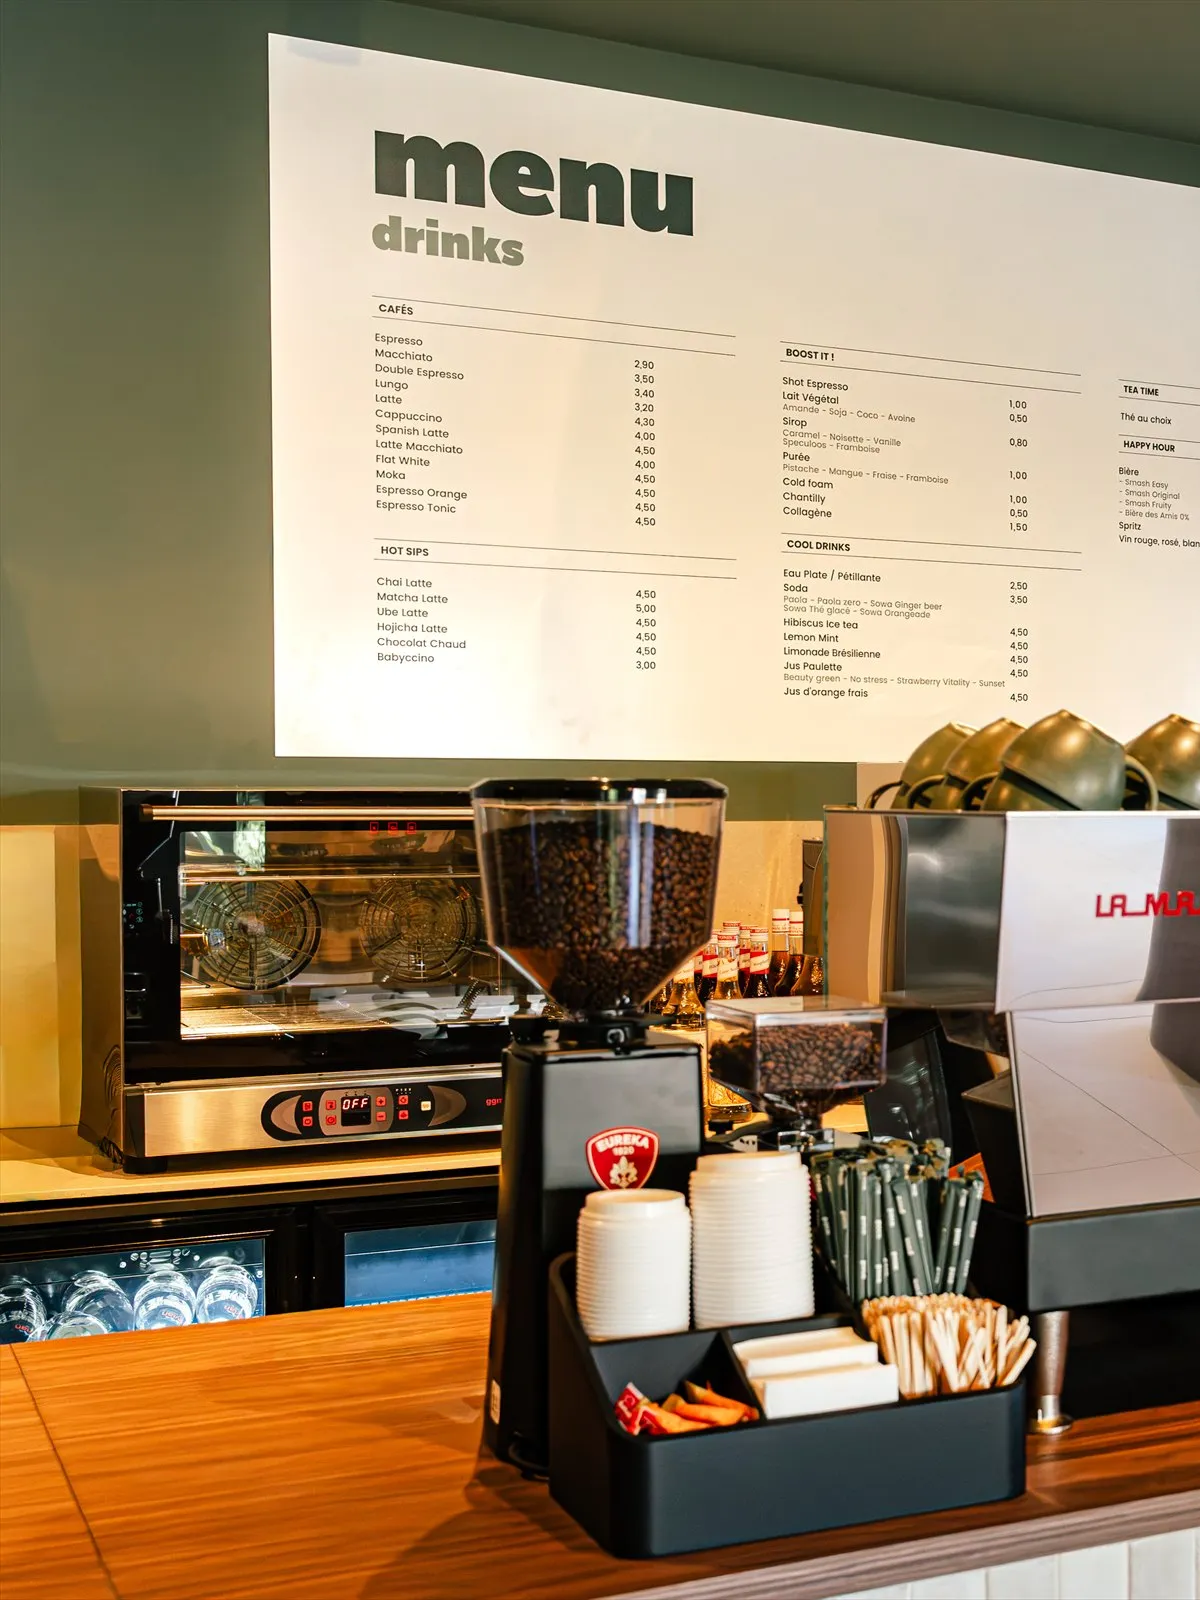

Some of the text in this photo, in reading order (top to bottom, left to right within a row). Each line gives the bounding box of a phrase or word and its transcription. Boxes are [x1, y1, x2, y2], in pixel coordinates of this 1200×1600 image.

[374, 130, 694, 237] menu
[372, 215, 525, 266] drinks
[378, 302, 414, 315] CAFÉS
[374, 332, 423, 346] Espresso
[374, 347, 433, 362] Macchiato
[785, 347, 830, 360] BOOST IT
[633, 359, 655, 370] 2,90
[374, 363, 465, 381] Double Espresso
[374, 378, 409, 391] Lungo
[633, 373, 655, 384] 3,50
[781, 375, 849, 392] Shot Espresso
[633, 387, 655, 399] 3,40
[1123, 384, 1160, 396] TEA TIME
[374, 393, 403, 404] Latte
[781, 390, 839, 405] Lait Végétal
[1008, 398, 1028, 409] 1,00
[633, 402, 655, 413] 3,20
[782, 402, 916, 423] Amande Soja Coco Avoine
[374, 408, 443, 423] Cappuccino
[633, 416, 655, 426] 4,30
[1008, 412, 1028, 423] 0,50
[1120, 411, 1172, 425] Thé au choix
[782, 416, 808, 429] Sirop
[374, 423, 449, 438] Spanish Latte
[633, 430, 655, 441] 4,00
[782, 428, 901, 447] Caramel Vanille
[1008, 437, 1028, 447] 0,80
[374, 438, 464, 454] Latte Macchiato
[633, 444, 655, 455] 4,50
[1123, 439, 1176, 452] HAPPY HOUR
[375, 454, 430, 467] Flat White
[782, 450, 810, 462] Purée
[633, 459, 655, 469] 4,00
[375, 469, 406, 480] Moka
[782, 463, 949, 484] Pistache Mangue Fraise Framboise
[1008, 469, 1028, 480] 1,00
[1118, 466, 1140, 476] Bière
[633, 473, 655, 484] 4,50
[782, 476, 834, 489] Cold foam
[1124, 477, 1169, 490] Smash Easy
[375, 484, 468, 501] Espresso Orange
[633, 487, 655, 498] 4,50
[782, 491, 826, 505] Chantilly
[1124, 488, 1180, 500] Smash Original
[1008, 494, 1028, 504] 1,00
[1124, 498, 1172, 510] Smash Fruity
[375, 499, 457, 513] Espresso Tonic
[633, 501, 655, 512] 4,50
[782, 505, 832, 518] Collagène
[1008, 507, 1028, 518] 0,50
[633, 516, 655, 527] 4,50
[1008, 521, 1028, 531] 1,50
[1118, 520, 1142, 531] Spritz
[786, 539, 851, 551] COOL DRINKS
[1118, 534, 1132, 543] Vin
[1133, 535, 1160, 546] rouge,
[1161, 536, 1181, 547] rosé,
[380, 544, 429, 557] HOT SIPS
[782, 568, 881, 582] Eau Plate Pétillante
[376, 576, 433, 589] Chai Latte
[782, 582, 808, 593] Soda
[1009, 580, 1028, 590] 2,50
[376, 591, 448, 604] Matcha Latte
[635, 588, 656, 599] 4,50
[1009, 594, 1028, 604] 3,50
[635, 602, 656, 613] 5,00
[783, 594, 942, 611] Paola Paola zero Sowa Ginger beer
[376, 606, 429, 618] Ube Latte
[376, 621, 448, 634] Hojicha Latte
[635, 617, 656, 627] 4,50
[783, 617, 859, 629] Hibiscus Ice tea
[635, 631, 656, 642] 4,50
[783, 632, 839, 643] Lemon Mint
[1009, 627, 1028, 637] 4,50
[376, 636, 466, 649] Chocolat Chaud
[1009, 640, 1028, 650] 4,50
[635, 645, 656, 656] 4,50
[783, 646, 881, 658] Limonade Brésilienne
[376, 651, 435, 664] Babyccino
[1009, 654, 1028, 664] 4,50
[635, 659, 656, 670] 3,00
[783, 661, 843, 671] Jus Paulette
[1009, 668, 1028, 678] 4,50
[783, 672, 1006, 688] Beauty green No stress Strawberry Vitality Sunset
[783, 686, 869, 699] Jus d'orange frais
[1009, 692, 1028, 702] 4,50
[342, 1097, 369, 1110] OFF
[595, 1133, 649, 1152] EUREKA
